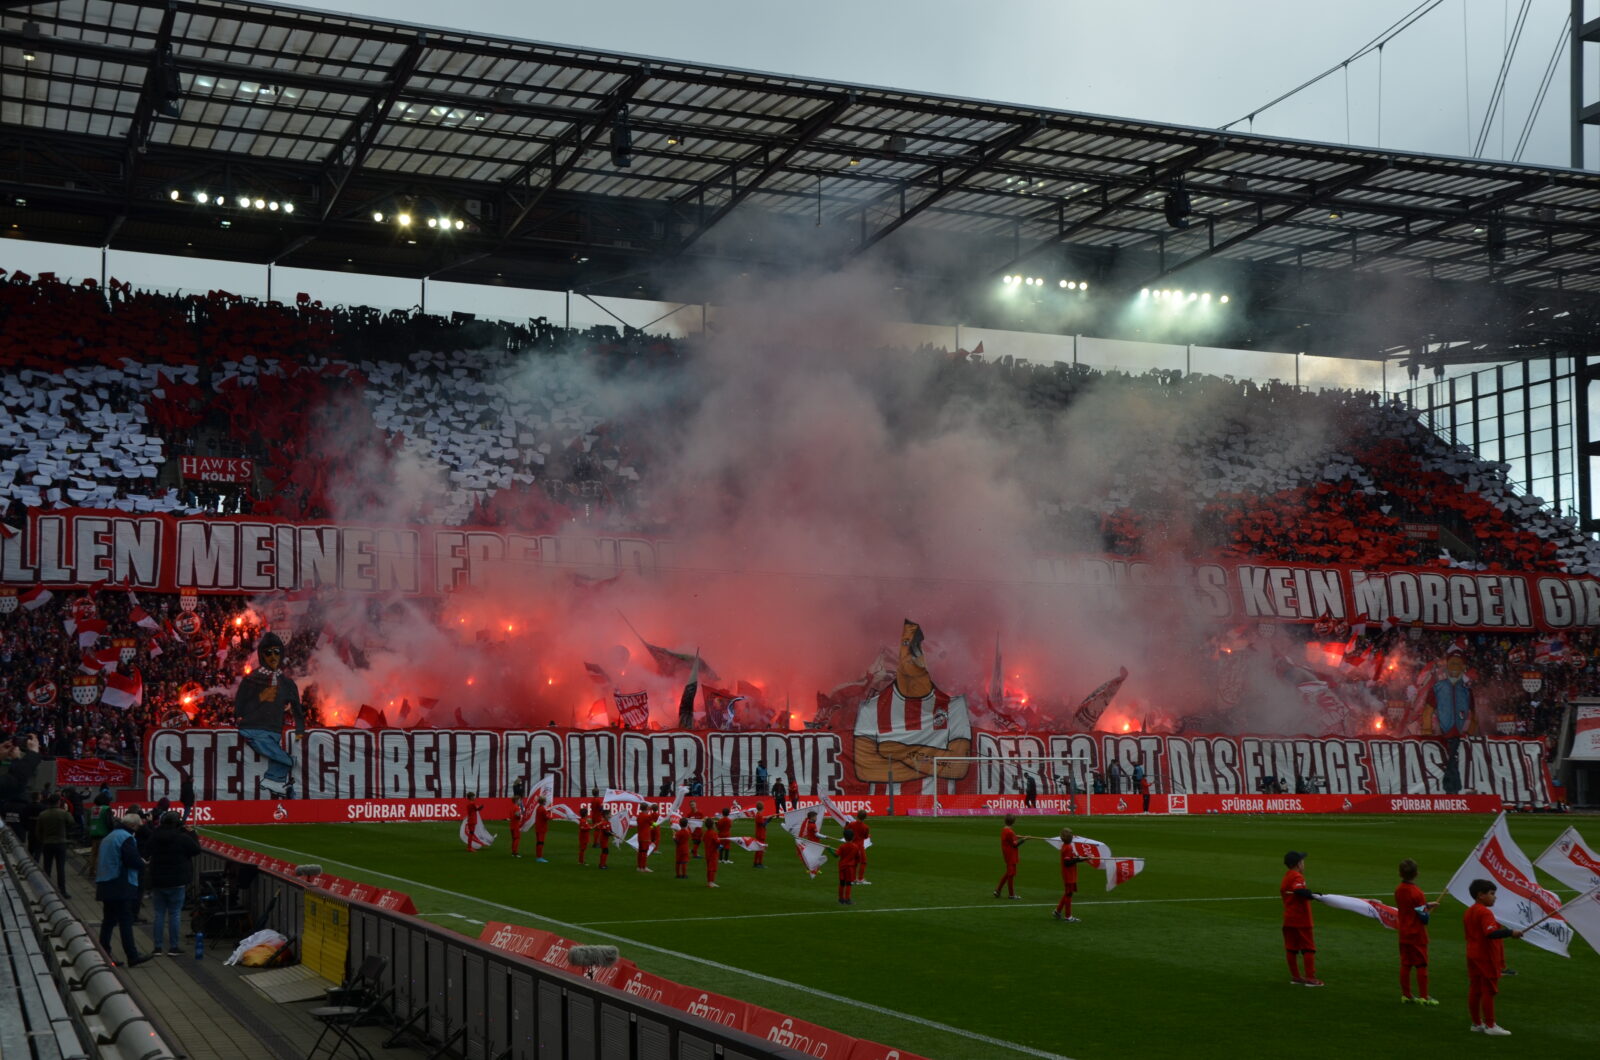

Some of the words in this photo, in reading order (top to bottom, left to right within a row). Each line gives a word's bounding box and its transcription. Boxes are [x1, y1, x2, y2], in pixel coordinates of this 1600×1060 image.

[182, 457, 253, 478] HAWKS
[201, 471, 236, 482] KÖLN
[178, 522, 419, 593] MEINEN
[1239, 565, 1346, 619] KEIN
[1351, 570, 1534, 628] MORGEN
[381, 731, 500, 799] BEIM
[504, 731, 563, 798] FC
[567, 732, 617, 798] IN
[623, 732, 705, 797] DER
[708, 732, 843, 796] KURVE
[977, 732, 1047, 794] DER
[1103, 735, 1164, 794] IST
[1167, 736, 1241, 794] DAS
[1242, 738, 1371, 795] EINZIGE
[1371, 738, 1450, 795] WAS
[348, 802, 406, 819] SPÜRBAR
[410, 803, 461, 818] ANDERS.
[1222, 797, 1264, 811] SPÜRBAR
[1266, 797, 1304, 811] ANDERS.
[1391, 797, 1431, 811] SPÜRBAR
[1433, 797, 1470, 811] ANDERS.
[489, 930, 535, 954] DERTOUR
